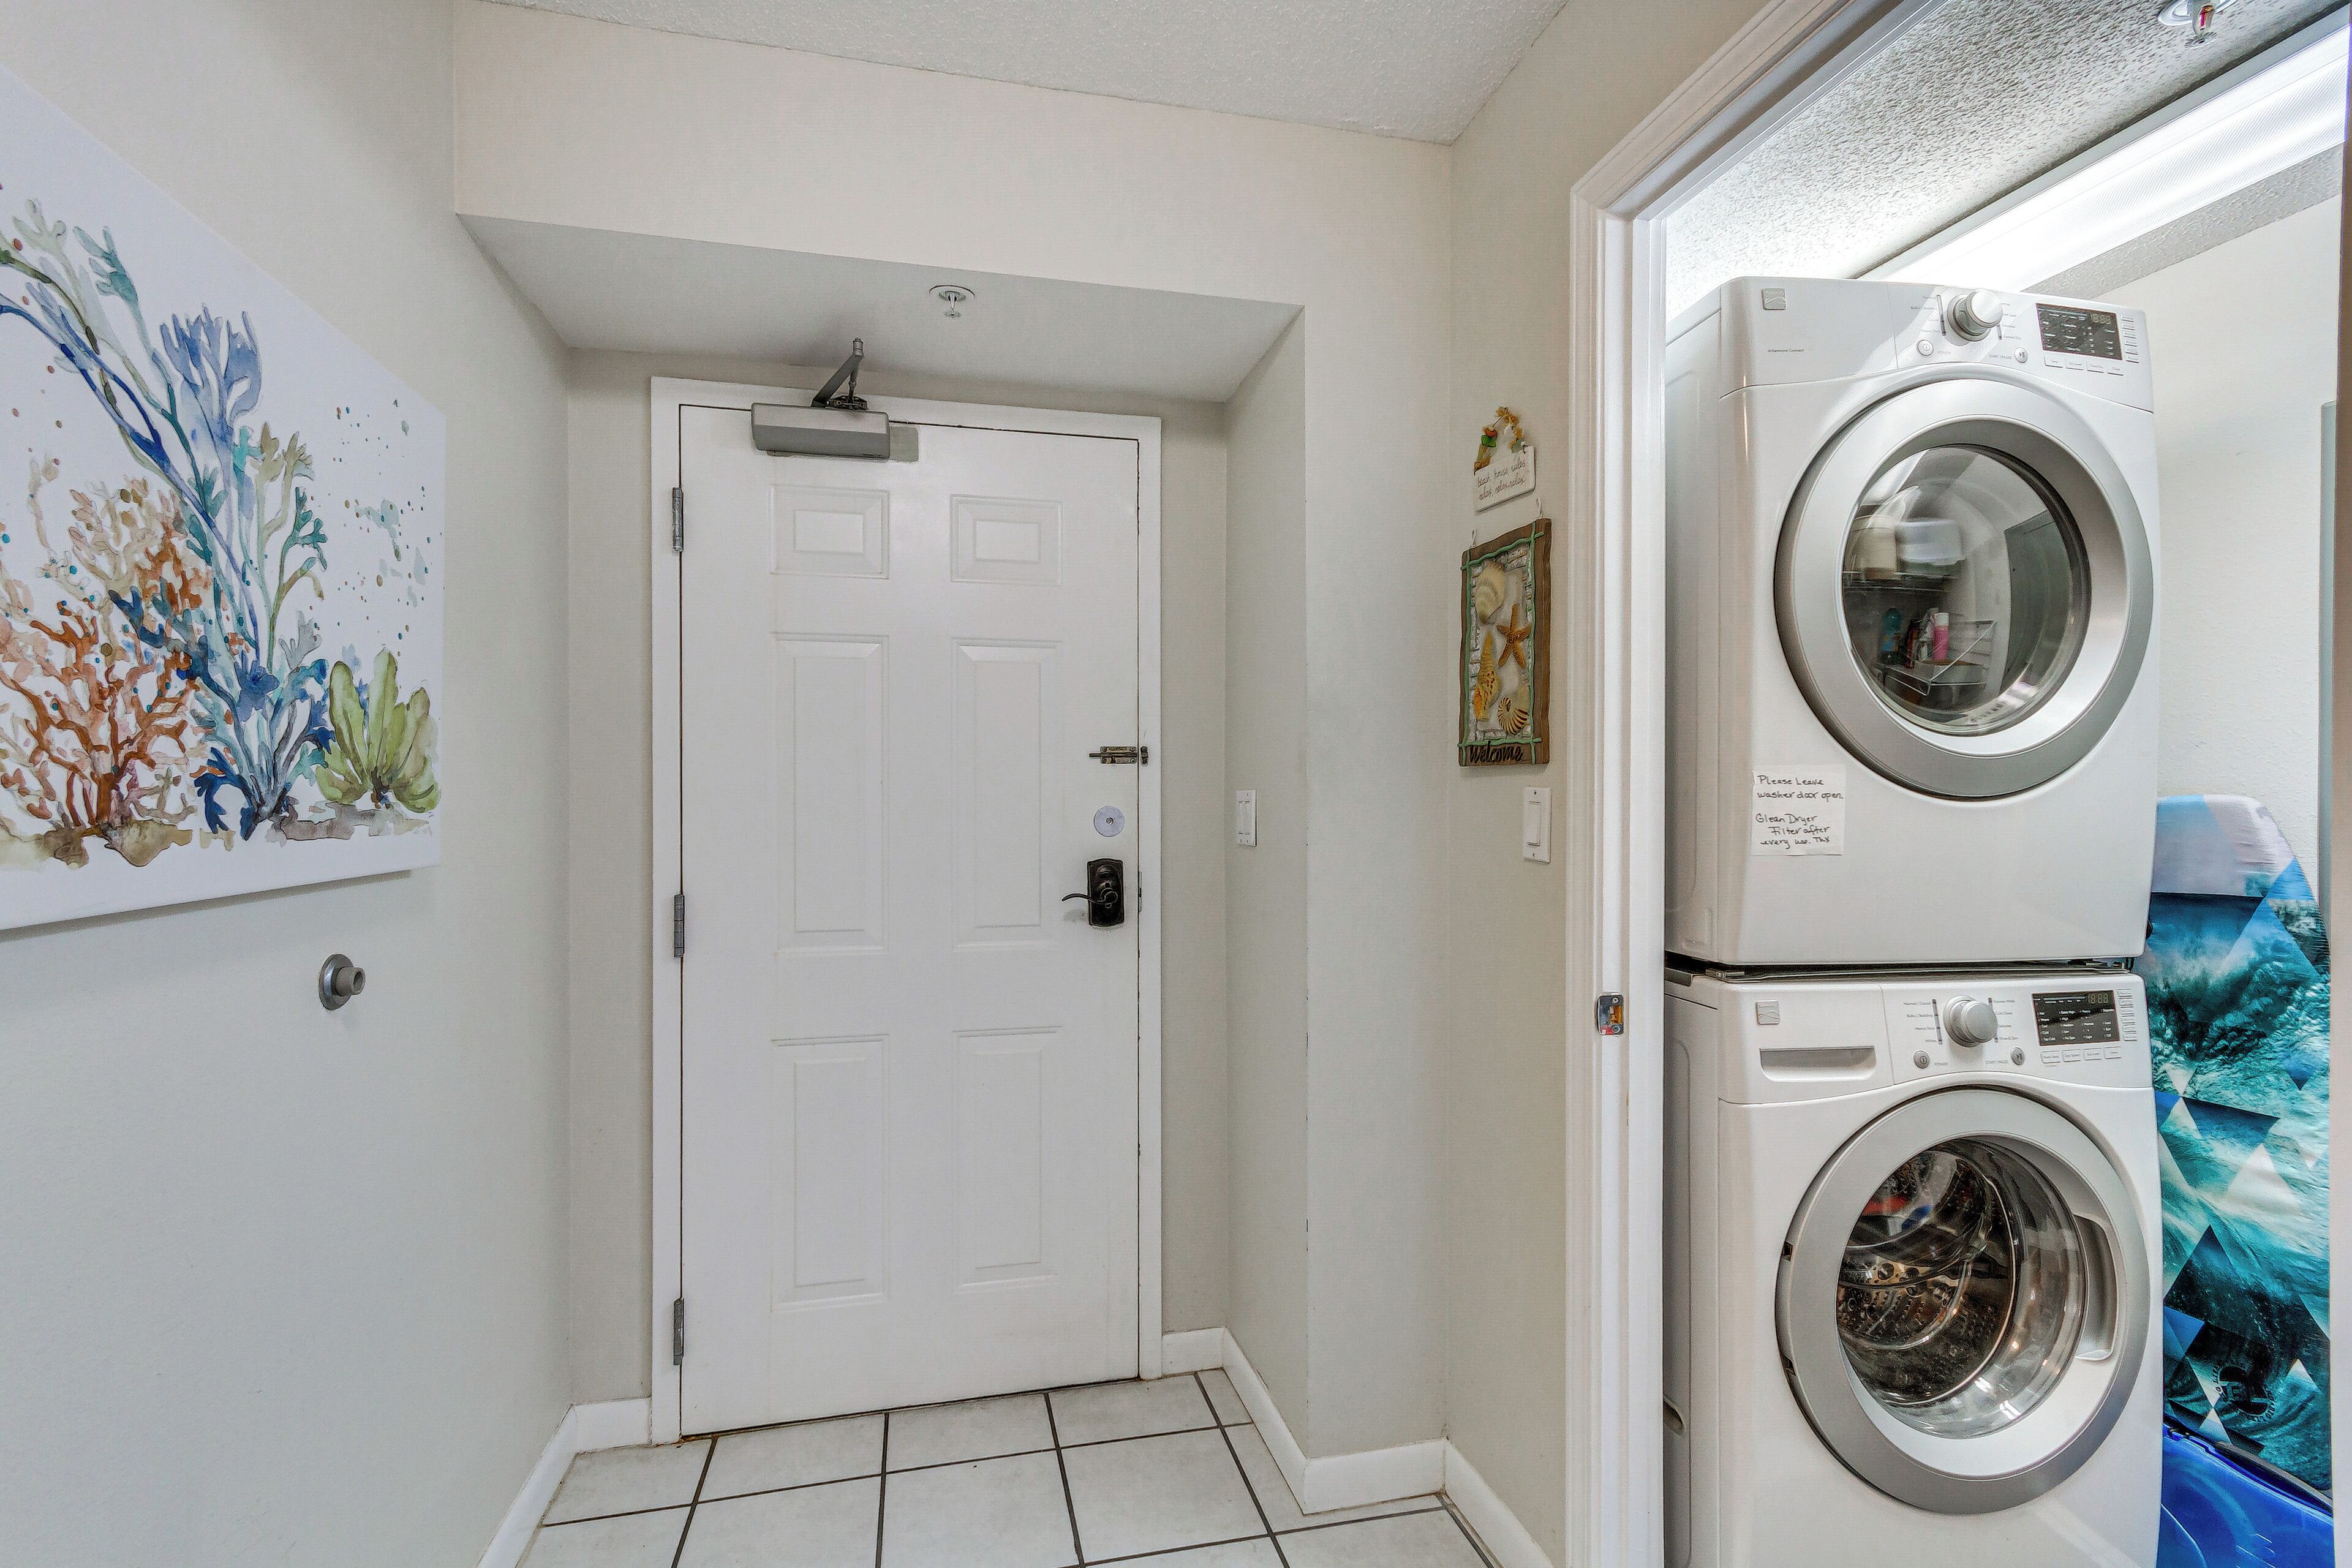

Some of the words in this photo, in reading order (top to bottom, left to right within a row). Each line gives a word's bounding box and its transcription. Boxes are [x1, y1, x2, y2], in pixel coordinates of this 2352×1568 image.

[1757, 775, 1792, 785] Please
[1785, 813, 1818, 826] Dryer
[1768, 826, 1801, 835] Filter
[1804, 824, 1830, 835] after
[1760, 838, 1790, 850] every
